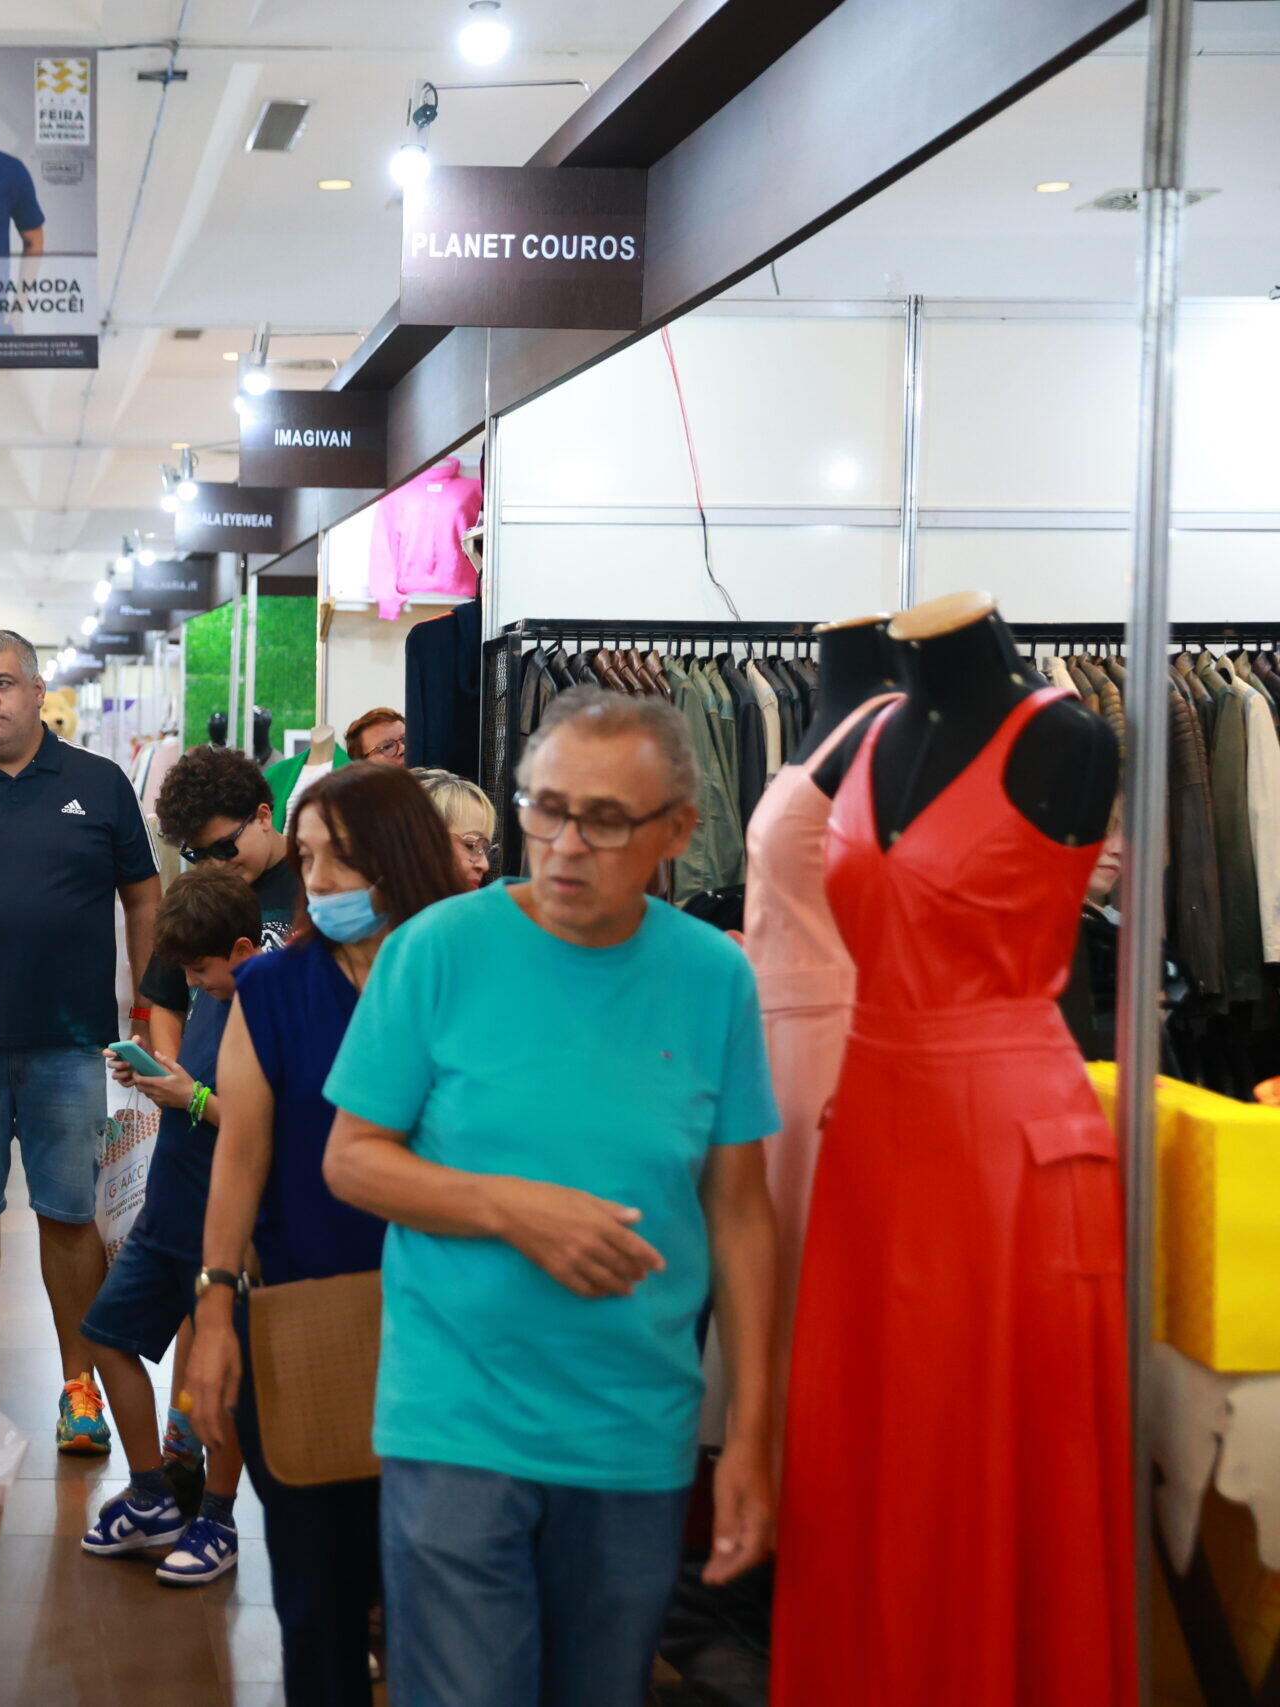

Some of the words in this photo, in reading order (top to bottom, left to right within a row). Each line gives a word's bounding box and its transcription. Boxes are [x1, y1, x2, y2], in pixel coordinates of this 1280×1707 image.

[40, 109, 84, 120] FEIRA
[411, 232, 515, 259] PLANET
[522, 234, 635, 260] COUROS
[22, 279, 81, 293] MODA
[27, 294, 84, 313] VOCÊ!
[274, 429, 351, 447] IMAGIVAN
[222, 513, 273, 528] EYEWEAR
[61, 808, 86, 816] adidas
